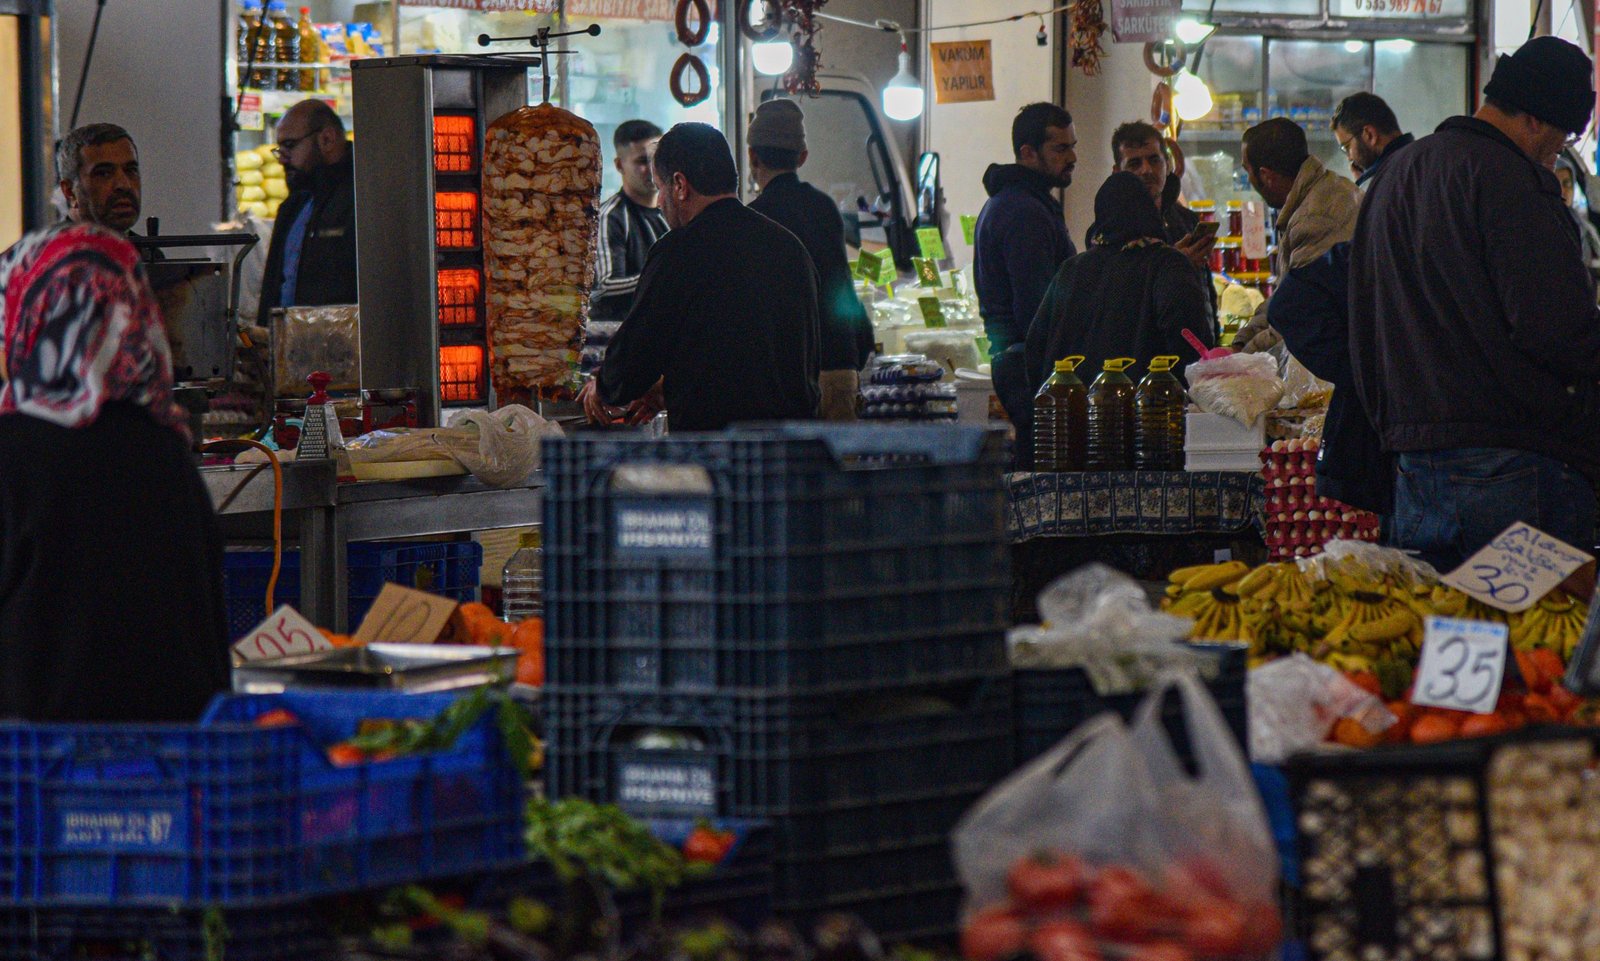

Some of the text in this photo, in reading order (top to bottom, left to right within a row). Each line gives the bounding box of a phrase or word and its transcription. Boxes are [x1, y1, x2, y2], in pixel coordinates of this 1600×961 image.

[938, 46, 985, 62] VAKUM
[943, 74, 985, 91] YAPILIR
[1457, 563, 1530, 605] 30
[1424, 636, 1499, 705] 35
